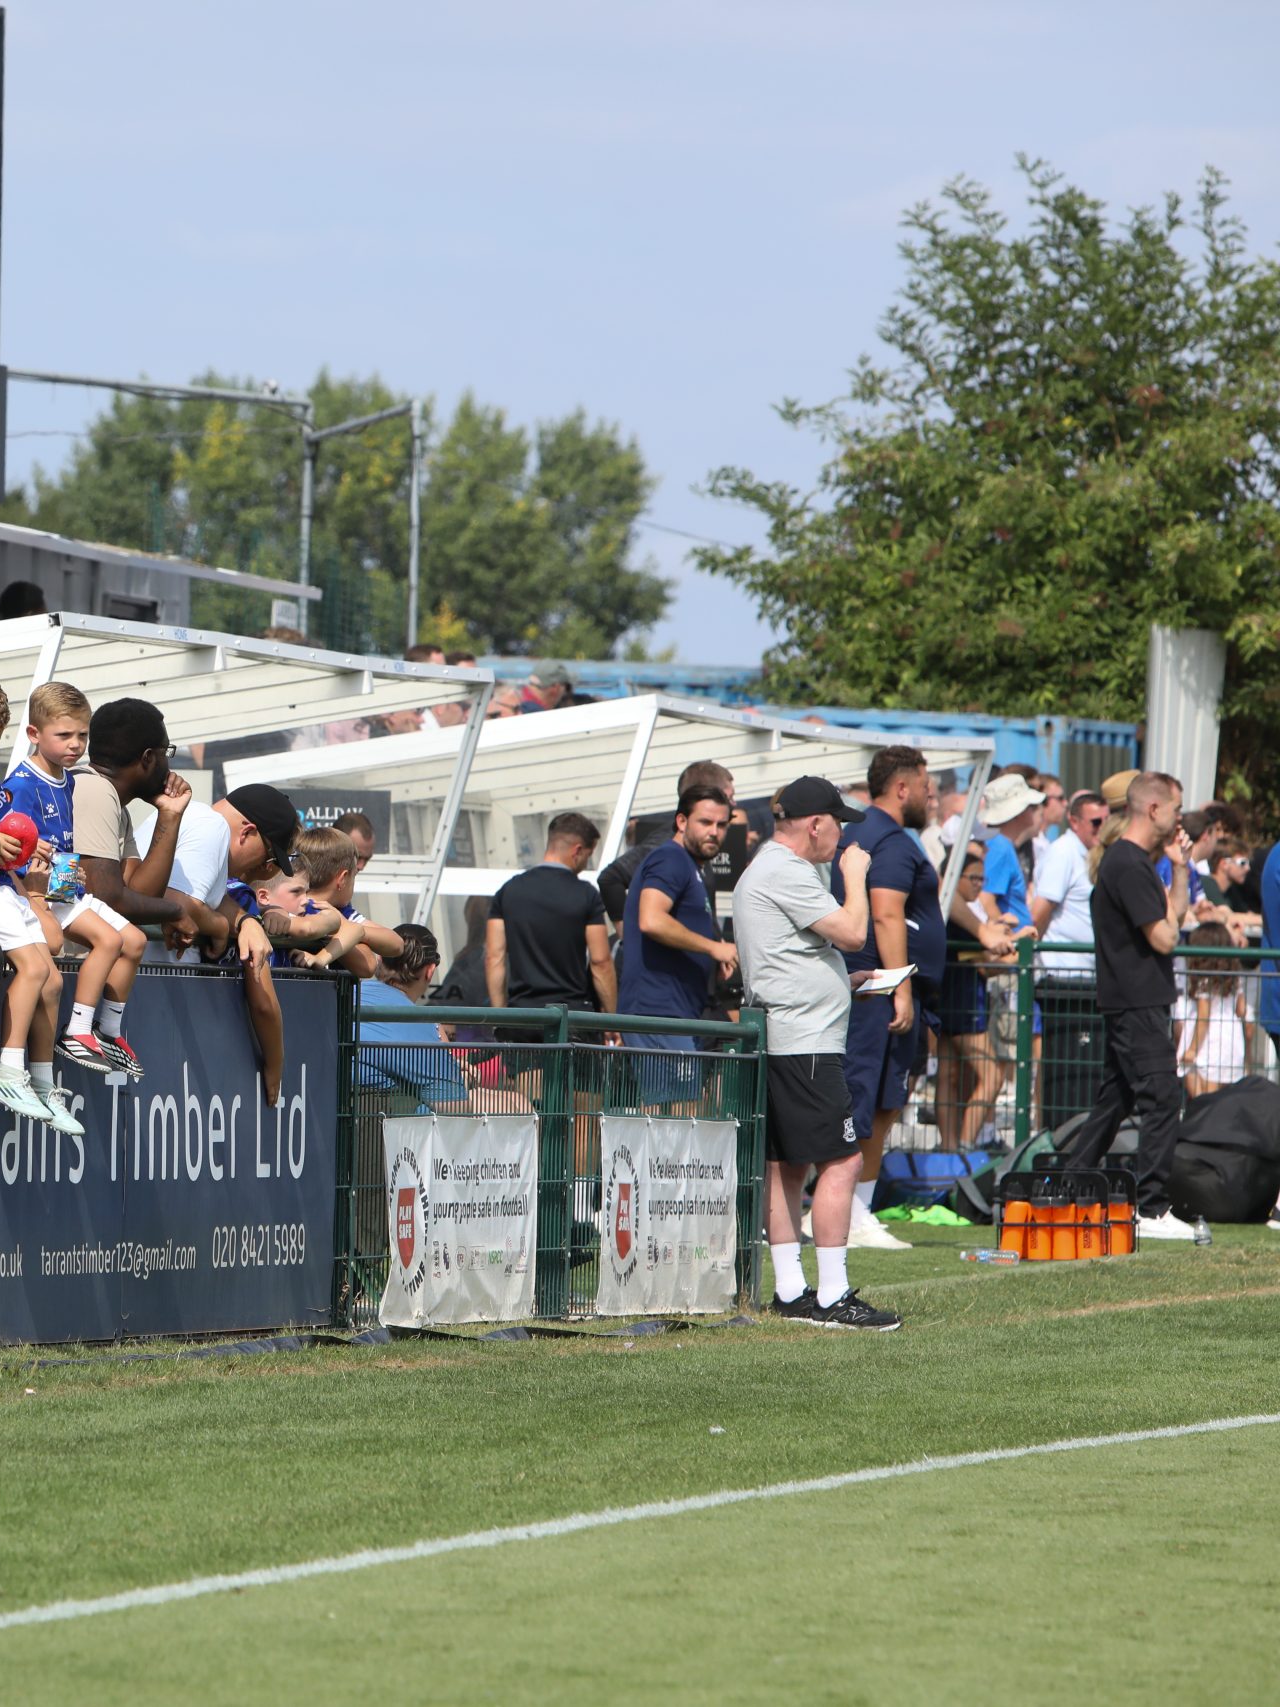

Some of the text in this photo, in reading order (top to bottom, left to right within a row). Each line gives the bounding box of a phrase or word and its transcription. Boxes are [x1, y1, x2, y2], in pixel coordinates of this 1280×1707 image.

[105, 1061, 241, 1181] Timber
[256, 1063, 306, 1179] Ltd
[480, 1158, 507, 1180] children
[664, 1159, 686, 1184] keepin
[399, 1205, 412, 1221] PLAY
[478, 1195, 491, 1218] safe
[500, 1193, 528, 1217] football
[665, 1195, 685, 1221] peopl
[398, 1223, 412, 1239] SAFE
[41, 1238, 197, 1280] tarrantstimber123@gmail.com
[212, 1226, 237, 1269] 020
[240, 1225, 270, 1267] 8421
[274, 1223, 305, 1266] 5989
